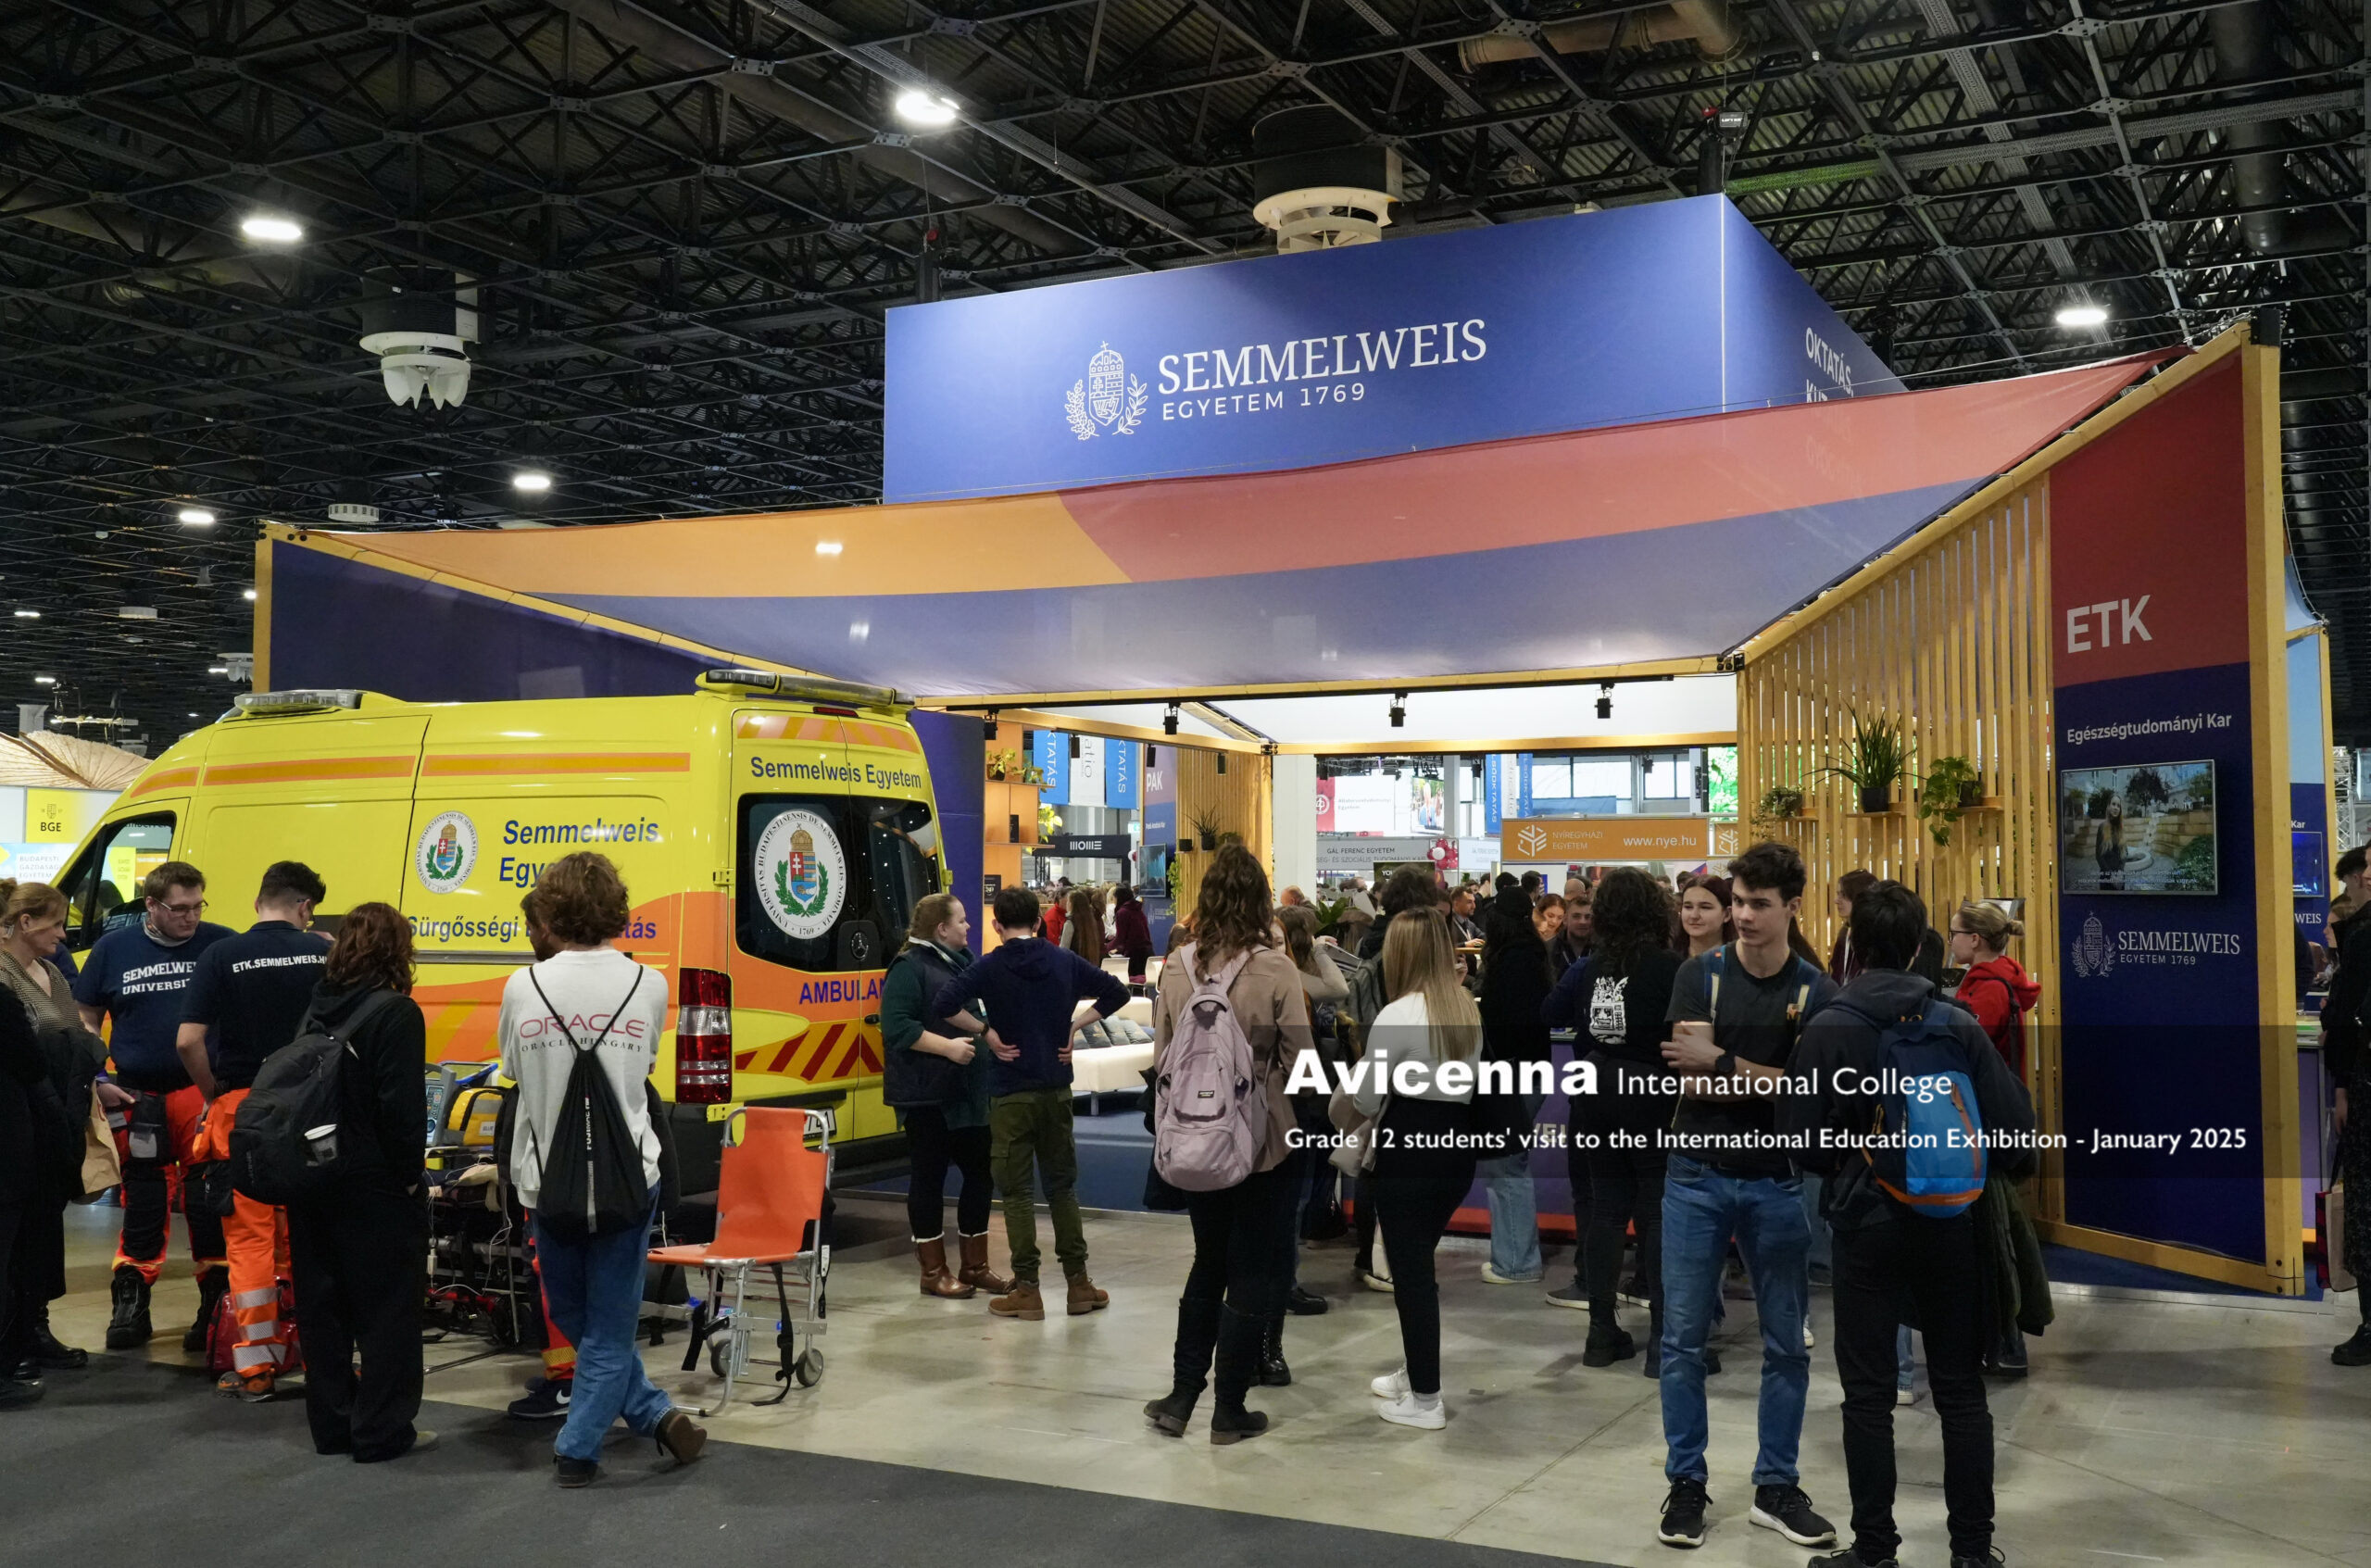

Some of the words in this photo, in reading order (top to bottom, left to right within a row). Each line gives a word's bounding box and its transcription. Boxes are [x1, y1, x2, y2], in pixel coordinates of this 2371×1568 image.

[1158, 319, 1487, 395] SEMMELWEIS
[1162, 391, 1284, 420] EGYETEM
[1300, 383, 1365, 407] 1769
[2066, 595, 2153, 653] ETK
[2066, 714, 2203, 745] Egészségtudományi
[2206, 712, 2232, 730] Kar
[1047, 732, 1058, 786] KTATÁS
[1085, 738, 1095, 778] atio
[1118, 740, 1127, 794] KTATÁS
[750, 756, 861, 783] Semmelweis
[865, 764, 922, 790] Egyetem
[1146, 771, 1163, 793] PAK
[40, 822, 62, 833] BGE
[503, 816, 659, 845] Semmelweis
[2291, 820, 2305, 829] Kar
[1623, 834, 1697, 848] www.nye.hu
[409, 915, 519, 943] Sürgősségi
[2294, 913, 2322, 924] WEIS
[798, 927, 815, 936] 1769
[2118, 931, 2240, 955] SEMMELWEIS
[232, 954, 327, 973] ETK.SEMMELWEIS.H
[2120, 954, 2166, 966] EGYETEM
[2171, 954, 2196, 966] 1769
[122, 961, 196, 984] SEMMELWE
[122, 978, 191, 996] UNIVERSI
[520, 1013, 646, 1038] ORACLE
[521, 1037, 576, 1053] ORACLE
[580, 1037, 644, 1053] HUNGARY
